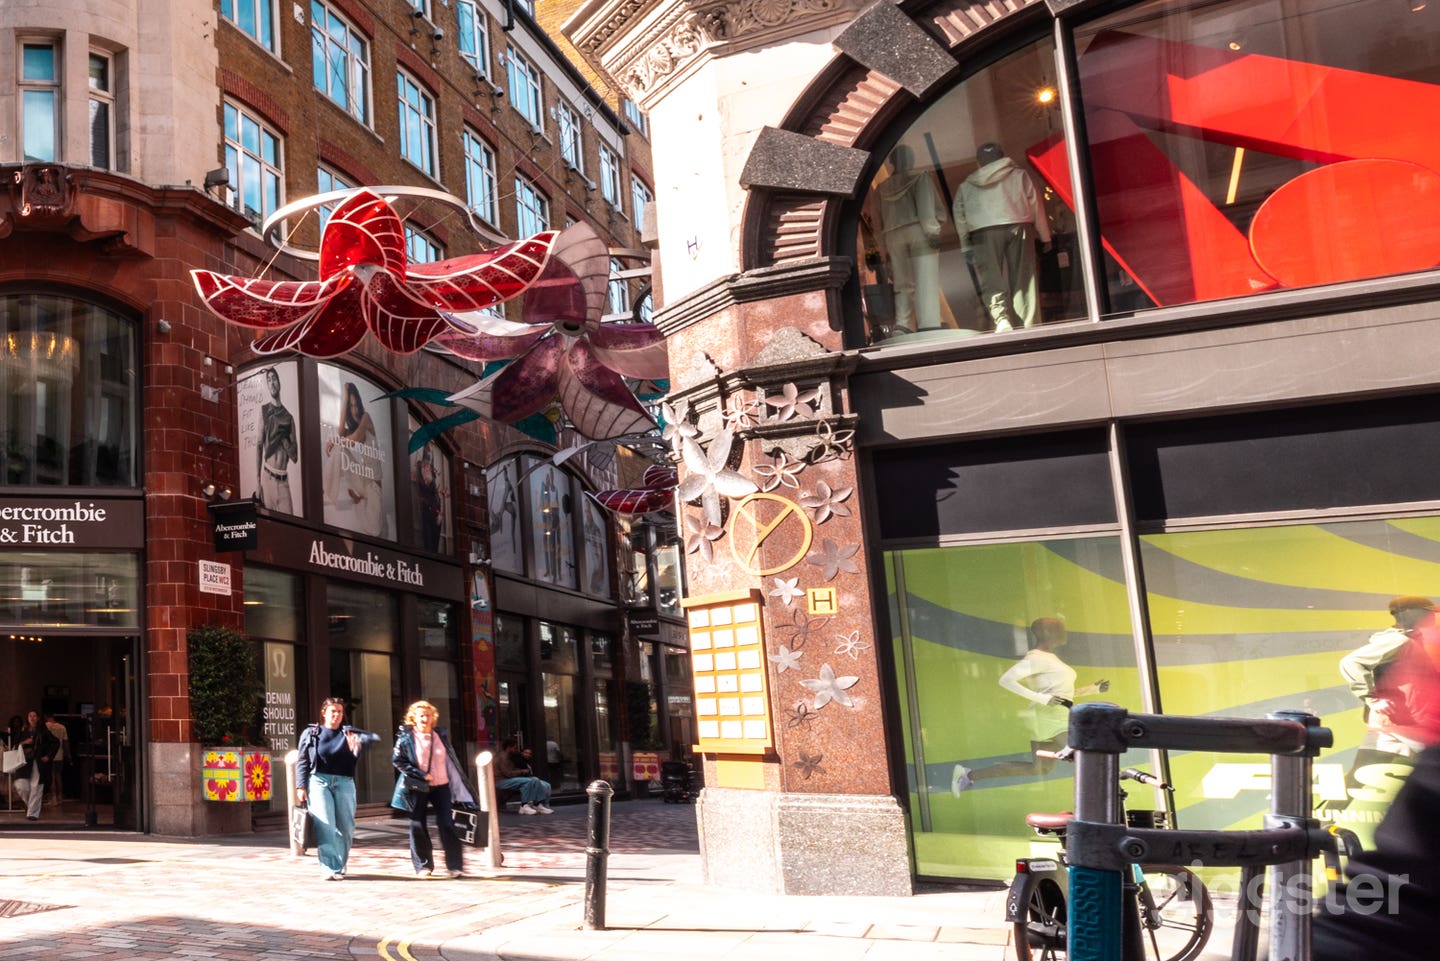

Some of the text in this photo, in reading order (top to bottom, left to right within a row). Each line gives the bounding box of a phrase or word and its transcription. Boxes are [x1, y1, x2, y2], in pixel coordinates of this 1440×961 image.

[341, 452, 375, 479] Denim
[216, 522, 256, 532] Abercrombie
[0, 524, 75, 543] & Fitch
[231, 530, 247, 539] Fitch
[203, 563, 226, 575] SLINGSBY
[309, 540, 424, 586] Abercrombie & Fitch
[203, 573, 229, 585] PLACE WC2
[266, 692, 291, 704] DENIM
[263, 707, 295, 720] SHOULD
[264, 723, 295, 735] FIT LIKE
[271, 738, 289, 750] THIS
[1202, 763, 1414, 802] FAS
[1311, 808, 1385, 824] UNNIN
